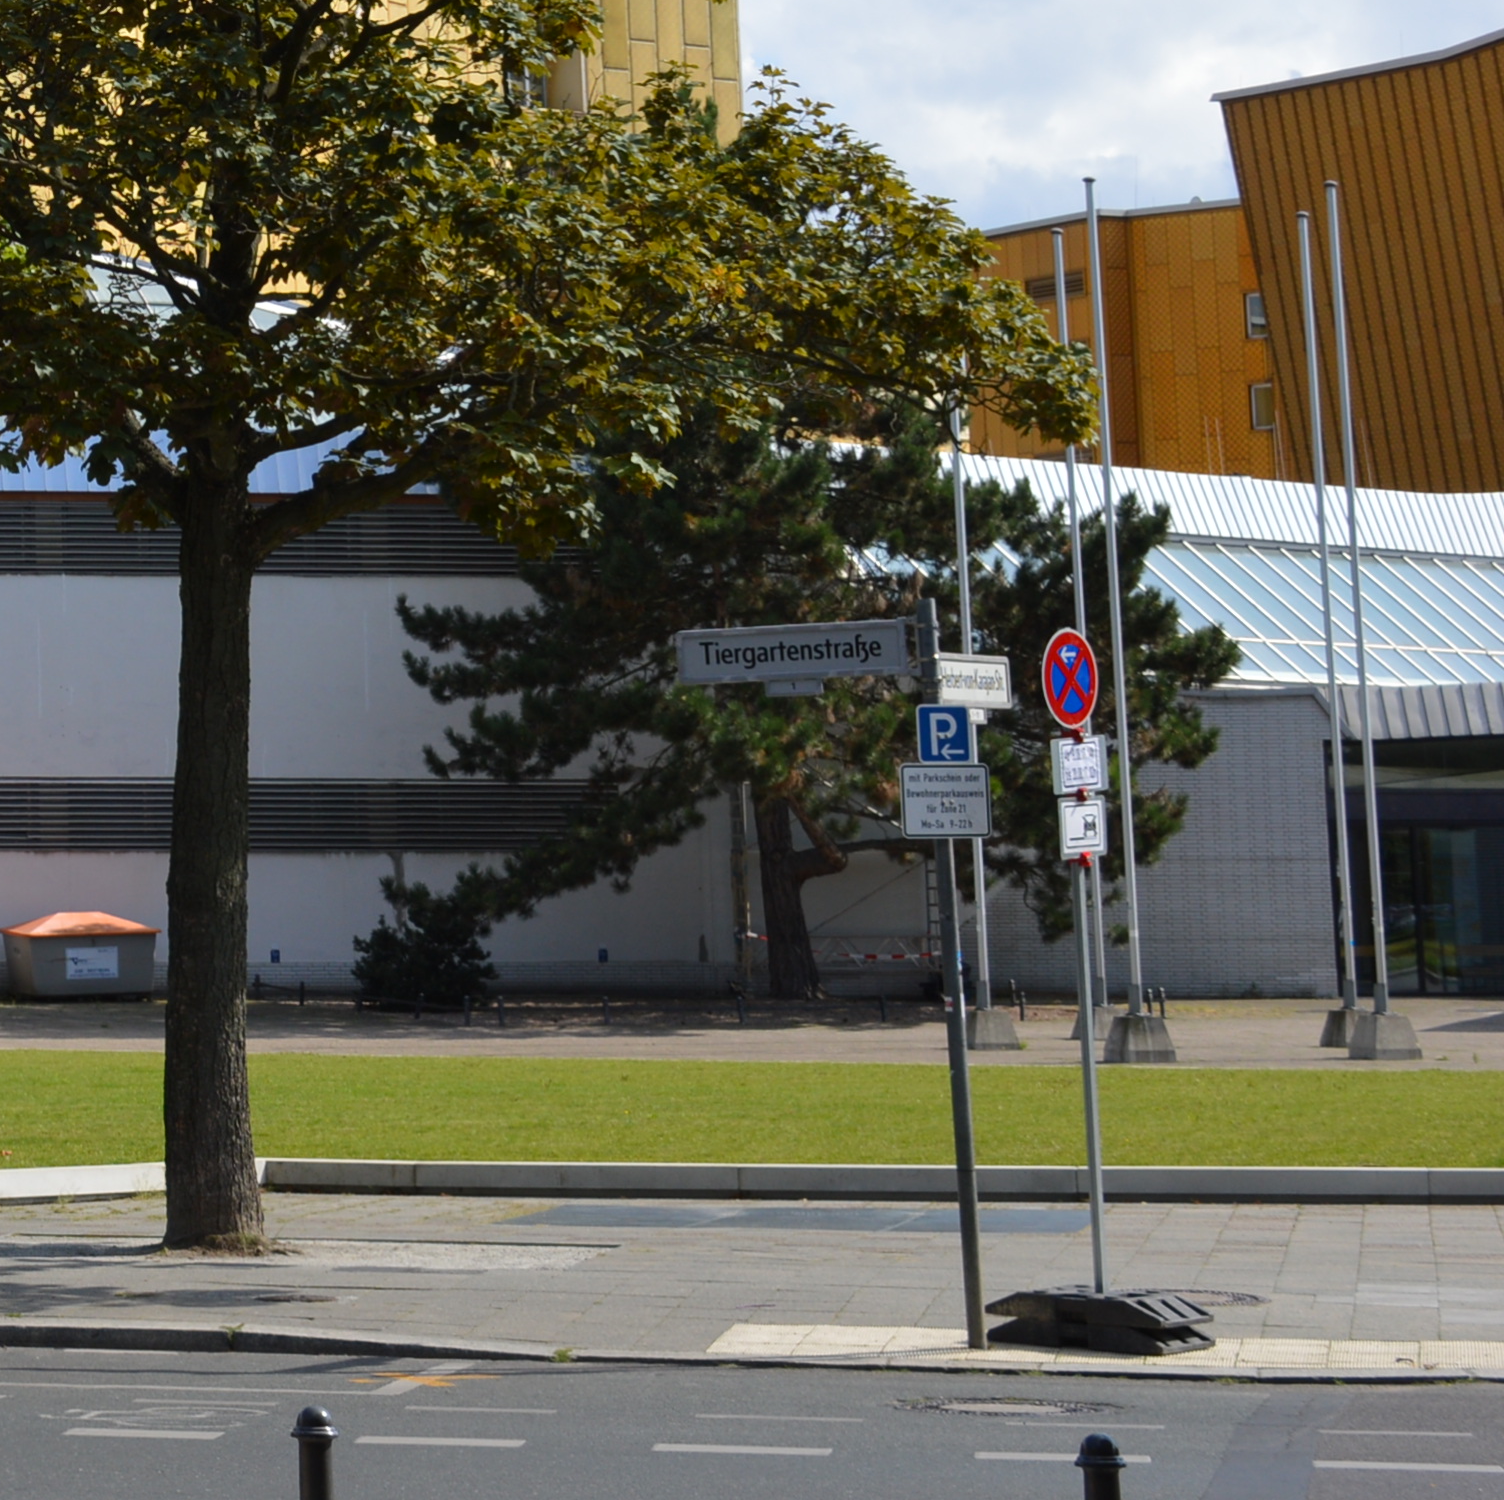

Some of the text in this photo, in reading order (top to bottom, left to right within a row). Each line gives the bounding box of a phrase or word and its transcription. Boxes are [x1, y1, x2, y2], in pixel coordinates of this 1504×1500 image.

[699, 634, 881, 669] Tiergartenstraße
[929, 712, 958, 757] P
[909, 773, 980, 782] mit Parkschein oder
[906, 788, 984, 800] Bewohnerparkausweis
[926, 803, 937, 813] für
[921, 819, 944, 829] Mo-Sa
